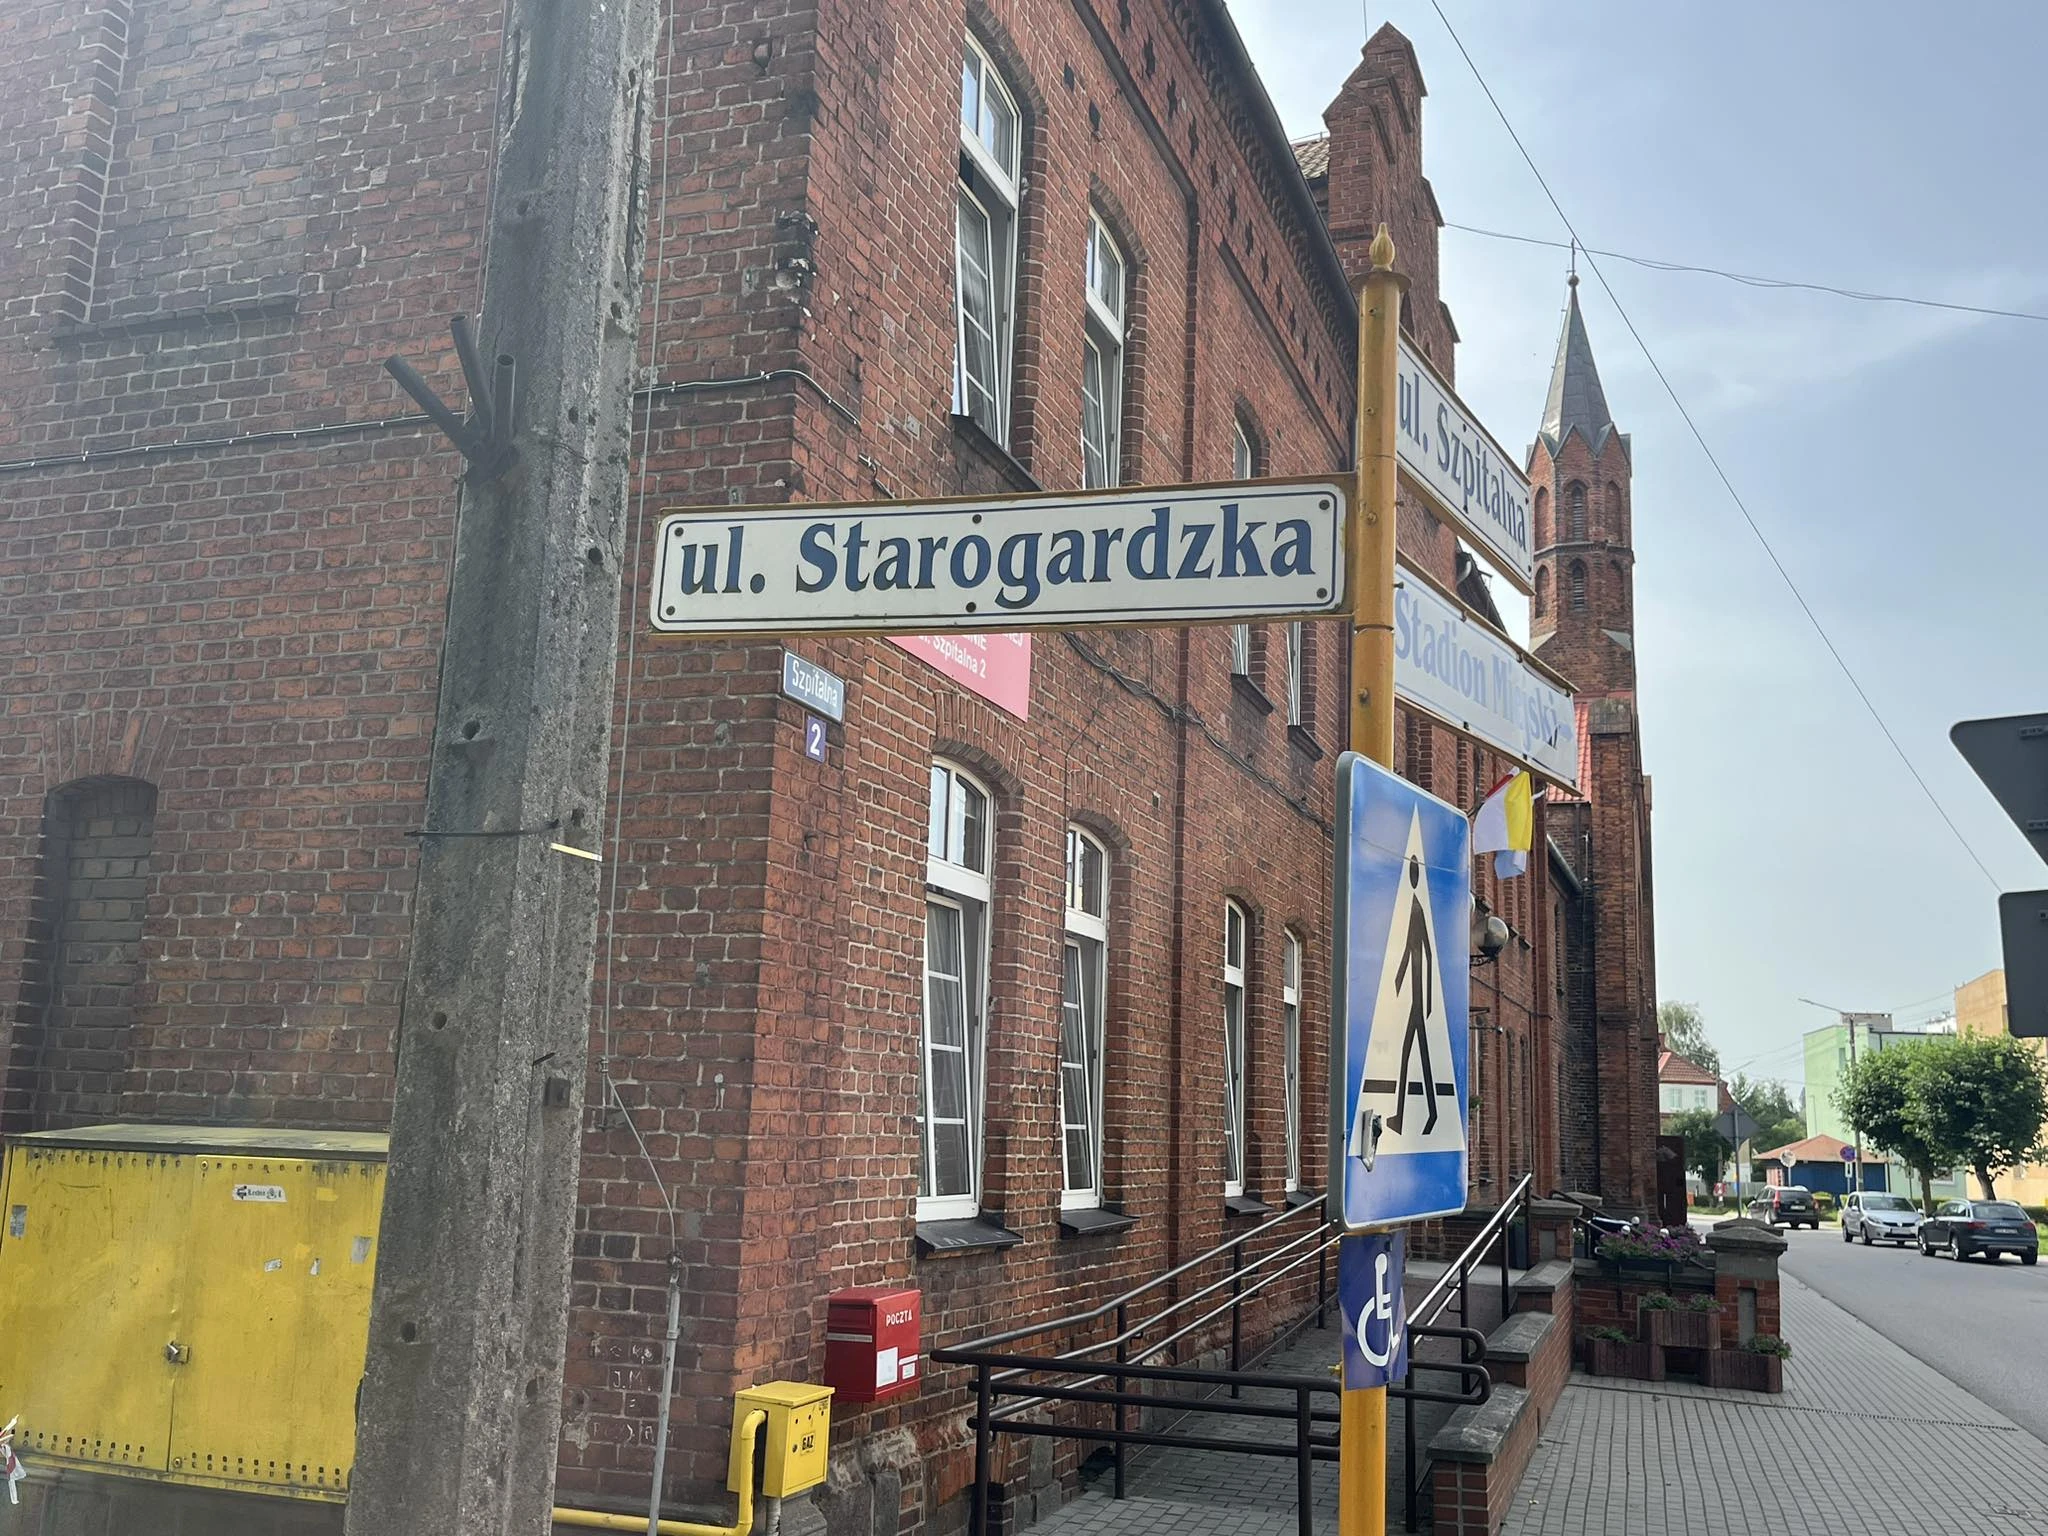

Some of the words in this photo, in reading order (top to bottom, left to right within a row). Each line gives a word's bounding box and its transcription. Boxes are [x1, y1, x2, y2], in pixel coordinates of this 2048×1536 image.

[1398, 372, 1429, 454] ul.
[1436, 402, 1527, 553] Szpitalna
[680, 525, 766, 596] ul.
[796, 501, 1316, 610] Starogardzka
[1395, 588, 1487, 709] Stadion
[792, 659, 838, 708] Szpitalna
[979, 659, 987, 680] 2
[810, 723, 822, 756] 2
[886, 1308, 913, 1328] POCZTA
[801, 1434, 814, 1451] GAZ
